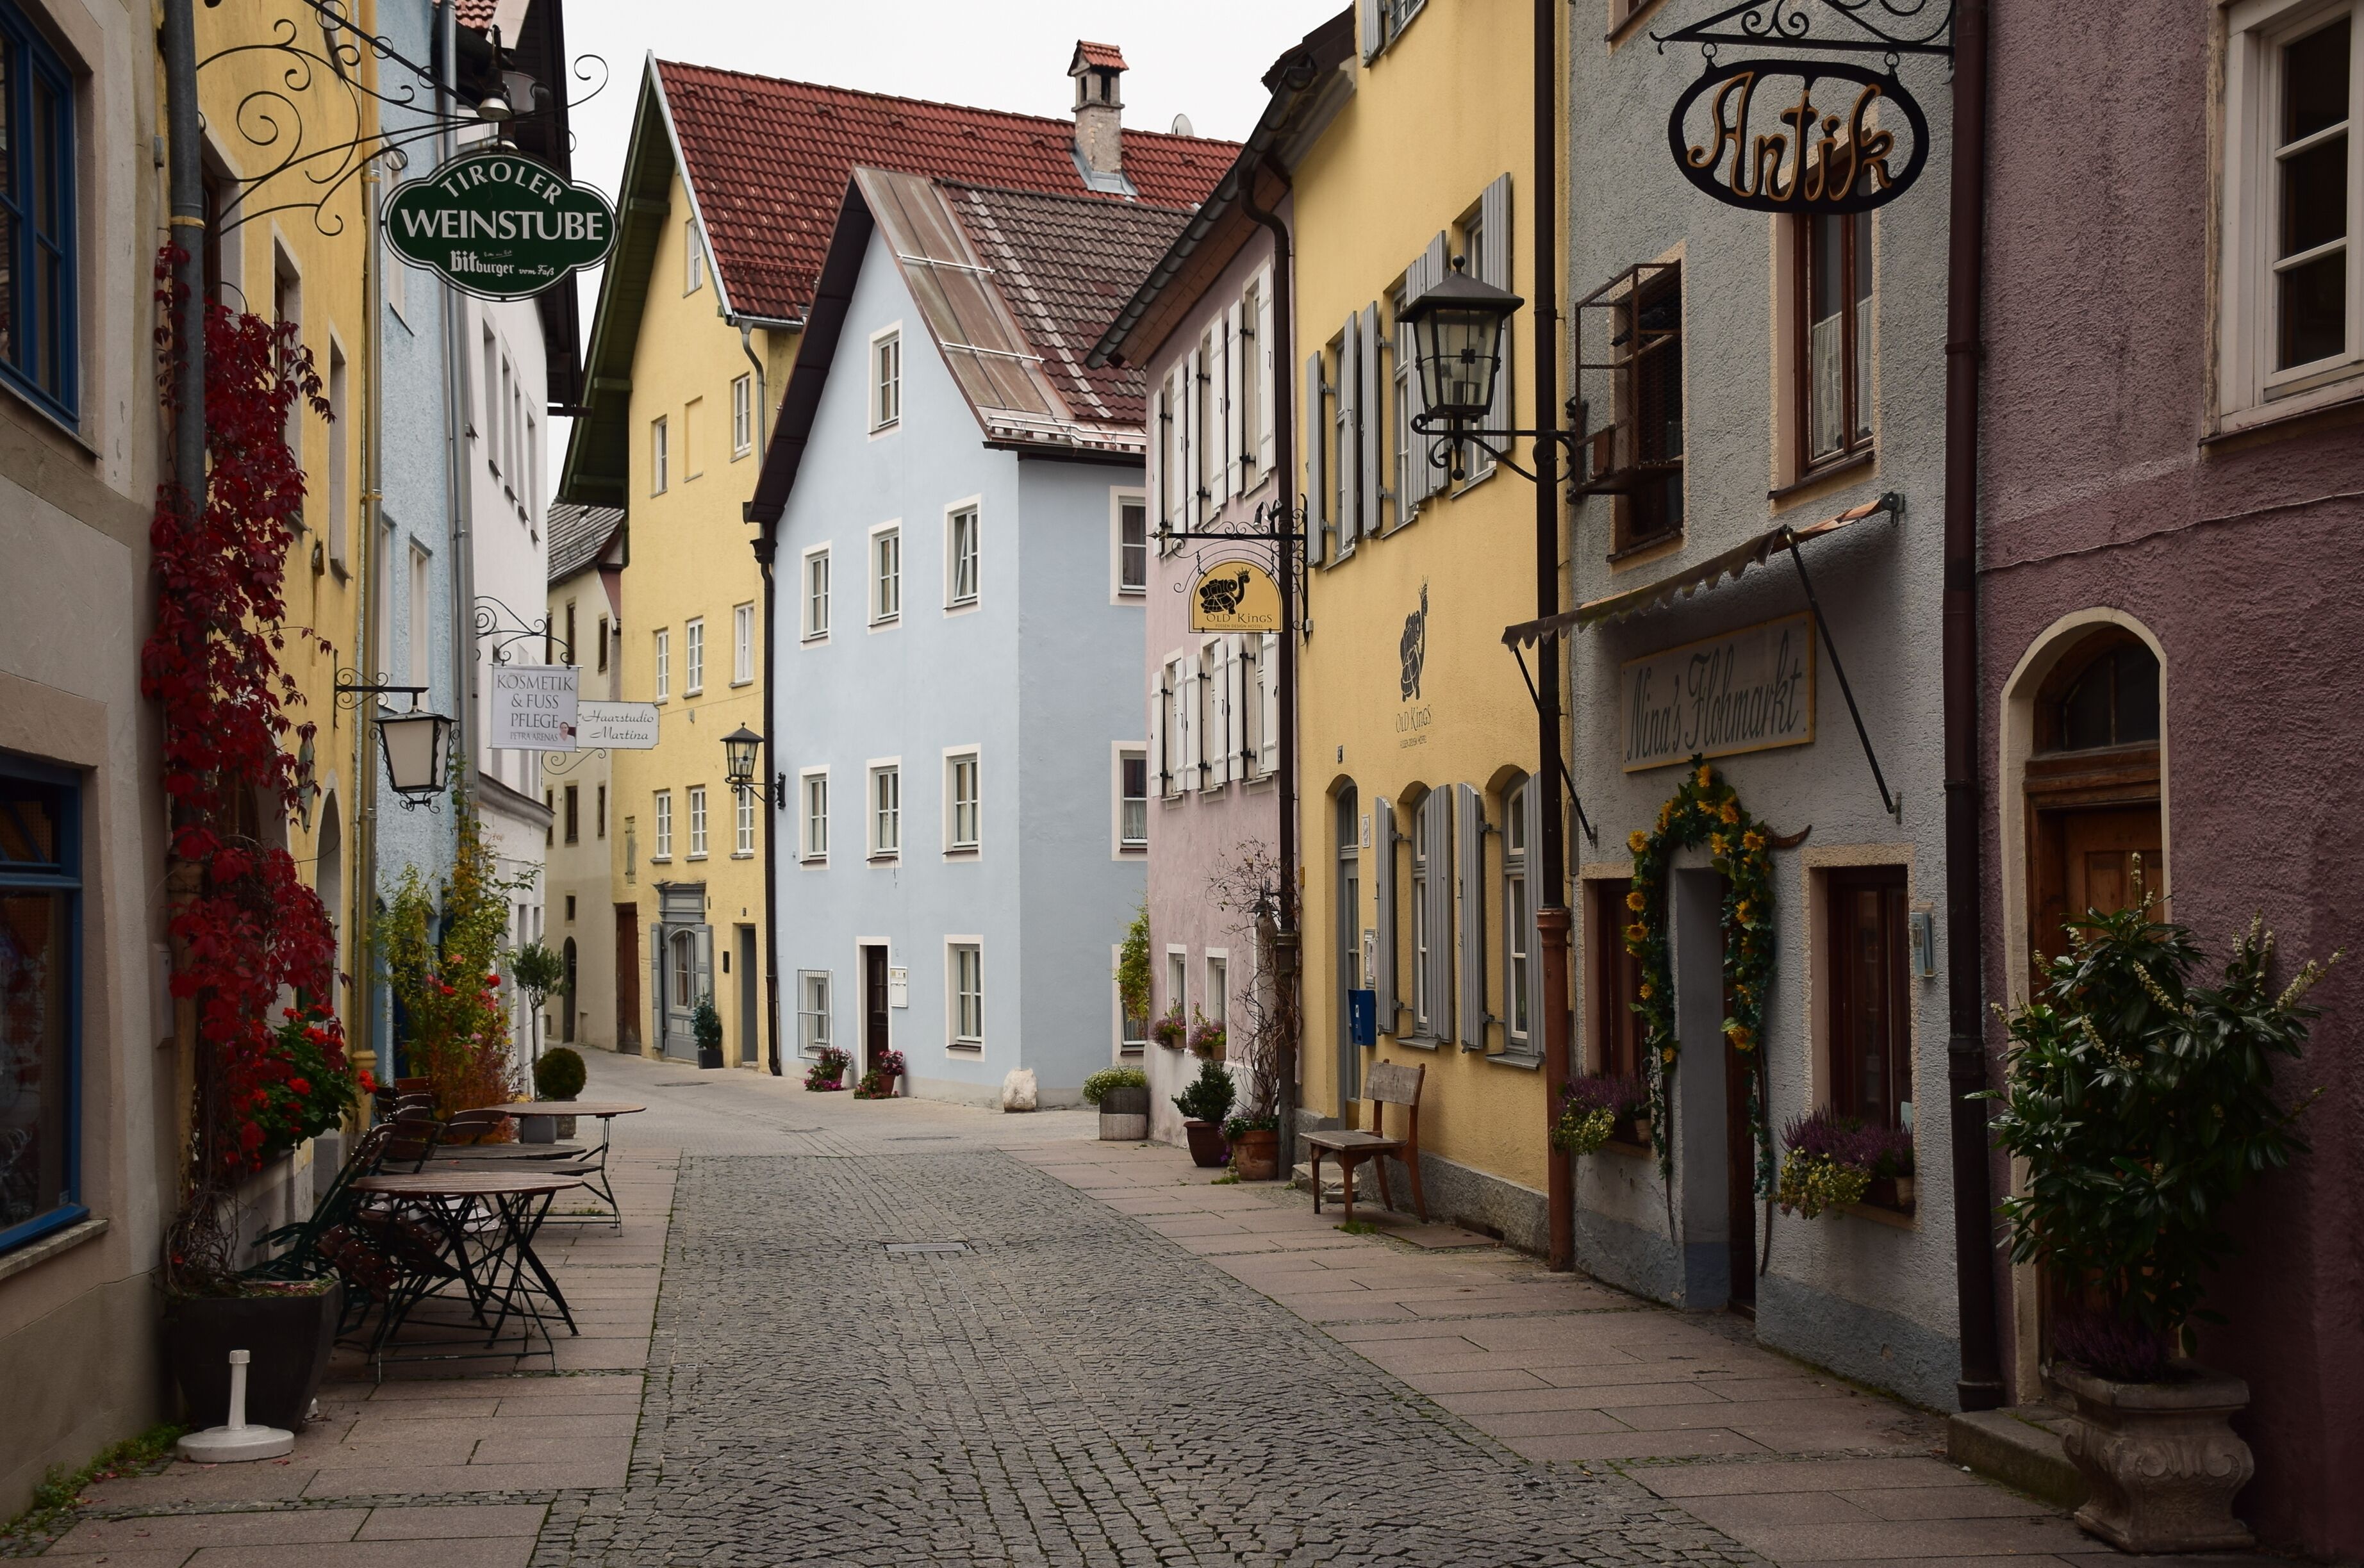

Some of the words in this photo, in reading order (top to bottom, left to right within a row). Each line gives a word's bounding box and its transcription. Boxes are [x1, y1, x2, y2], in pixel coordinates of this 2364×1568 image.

[1687, 70, 1895, 202] Antik
[440, 162, 561, 205] TIROLER
[401, 209, 604, 241] WEINSTUBE
[450, 250, 515, 277] Bitburger
[537, 264, 554, 277] Faß
[1207, 613, 1230, 622] OLD
[497, 674, 574, 691] KOSMETIK
[511, 693, 523, 707] &
[527, 694, 559, 709] FUSS
[1626, 666, 1682, 761] Nina's
[1684, 628, 1803, 750] Flohmarkt
[511, 713, 559, 729] PFLEGE
[581, 709, 654, 723] Haarstudio
[510, 732, 531, 740] PETRA
[532, 732, 558, 741] ARENAS
[590, 726, 649, 740] Martina
